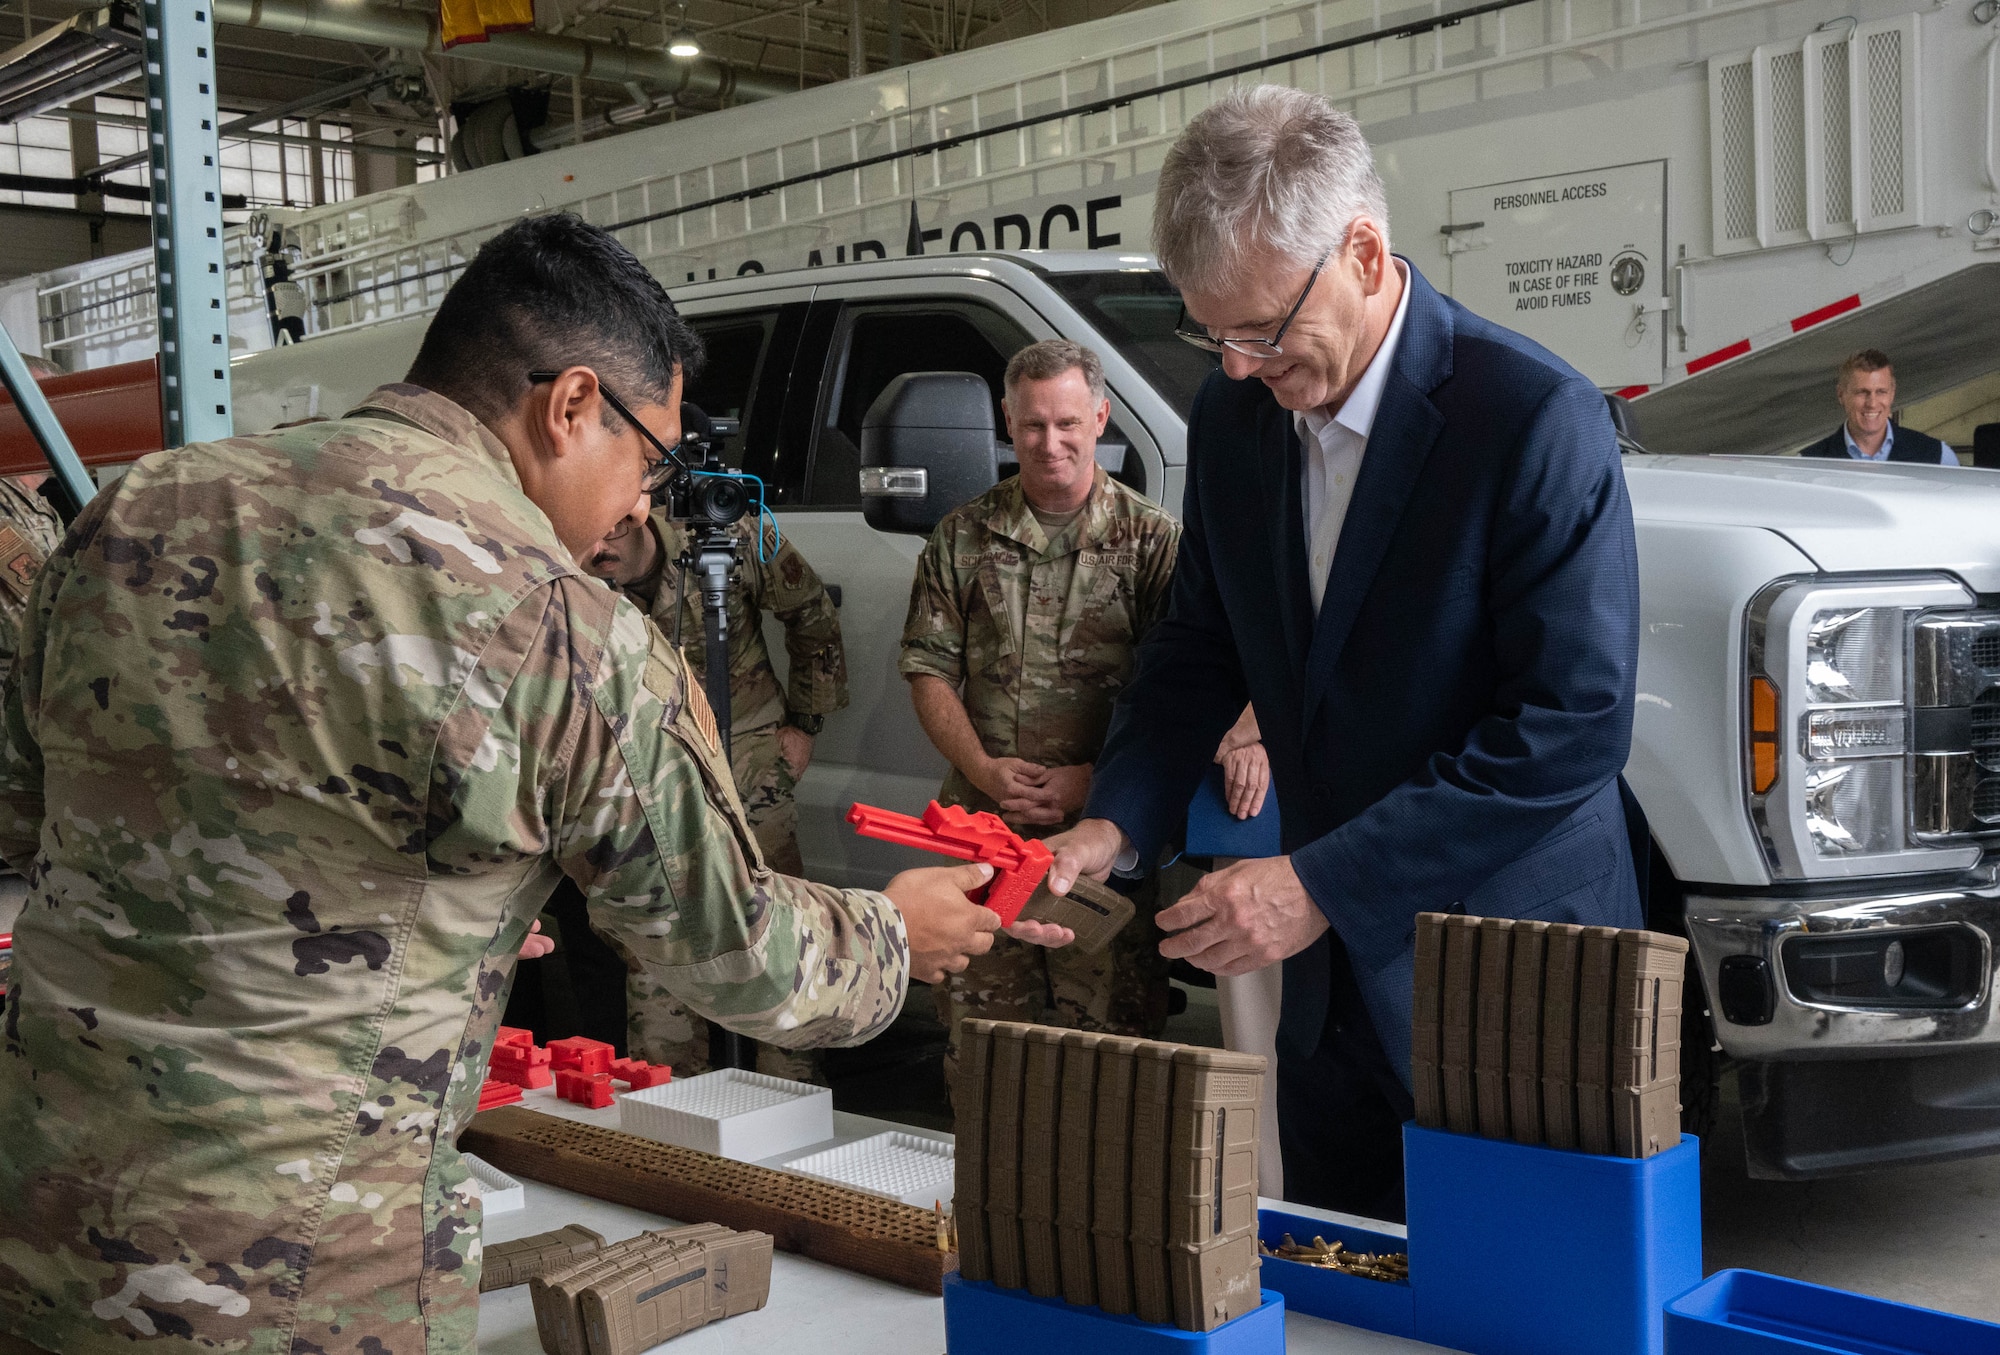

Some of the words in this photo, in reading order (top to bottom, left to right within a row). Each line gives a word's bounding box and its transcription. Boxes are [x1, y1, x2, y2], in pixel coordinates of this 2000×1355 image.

[1494, 190, 1559, 211] PERSONNEL
[1562, 183, 1607, 201] ACCESS
[1505, 258, 1553, 276] TOXICITY
[1557, 253, 1602, 270] HAZARD
[1509, 281, 1520, 294] IN
[1523, 277, 1552, 292] CASE
[1555, 275, 1570, 289] OF
[1574, 272, 1599, 287] FIRE
[1515, 295, 1548, 311] AVOID
[1552, 291, 1591, 307] FUMES
[1099, 554, 1116, 566] AIR
[1117, 554, 1138, 566] FOR
